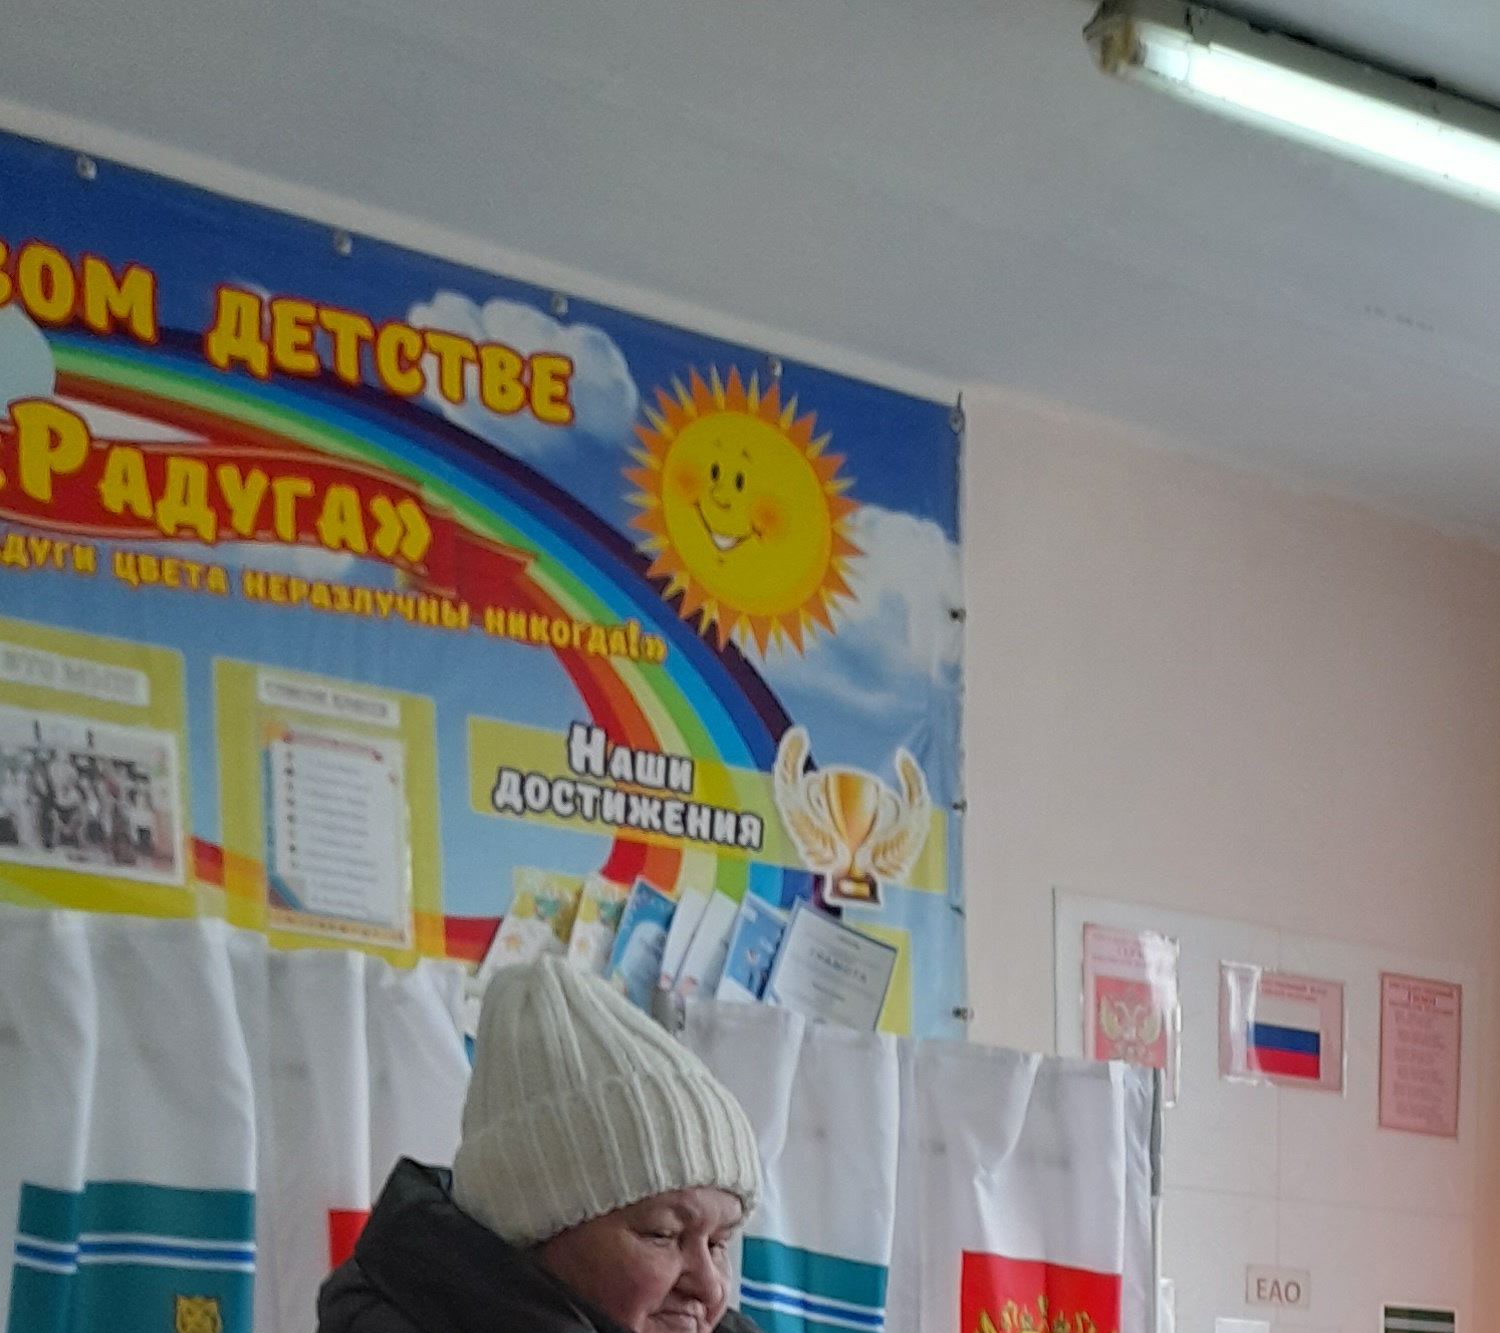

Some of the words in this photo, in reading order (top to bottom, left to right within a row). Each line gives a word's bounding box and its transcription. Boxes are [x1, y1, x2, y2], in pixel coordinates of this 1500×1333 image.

[0, 237, 158, 345] ОМ
[205, 284, 575, 427] ДЕТСТВЕ
[0, 400, 433, 563] РАДУГА»
[112, 551, 229, 597] ЦВЕТА
[242, 569, 470, 630] НЕРАЗЛУЧНЫ
[492, 767, 764, 851] ДОСТИЖЕНИЯ
[1256, 1277, 1302, 1304] ЕАО
